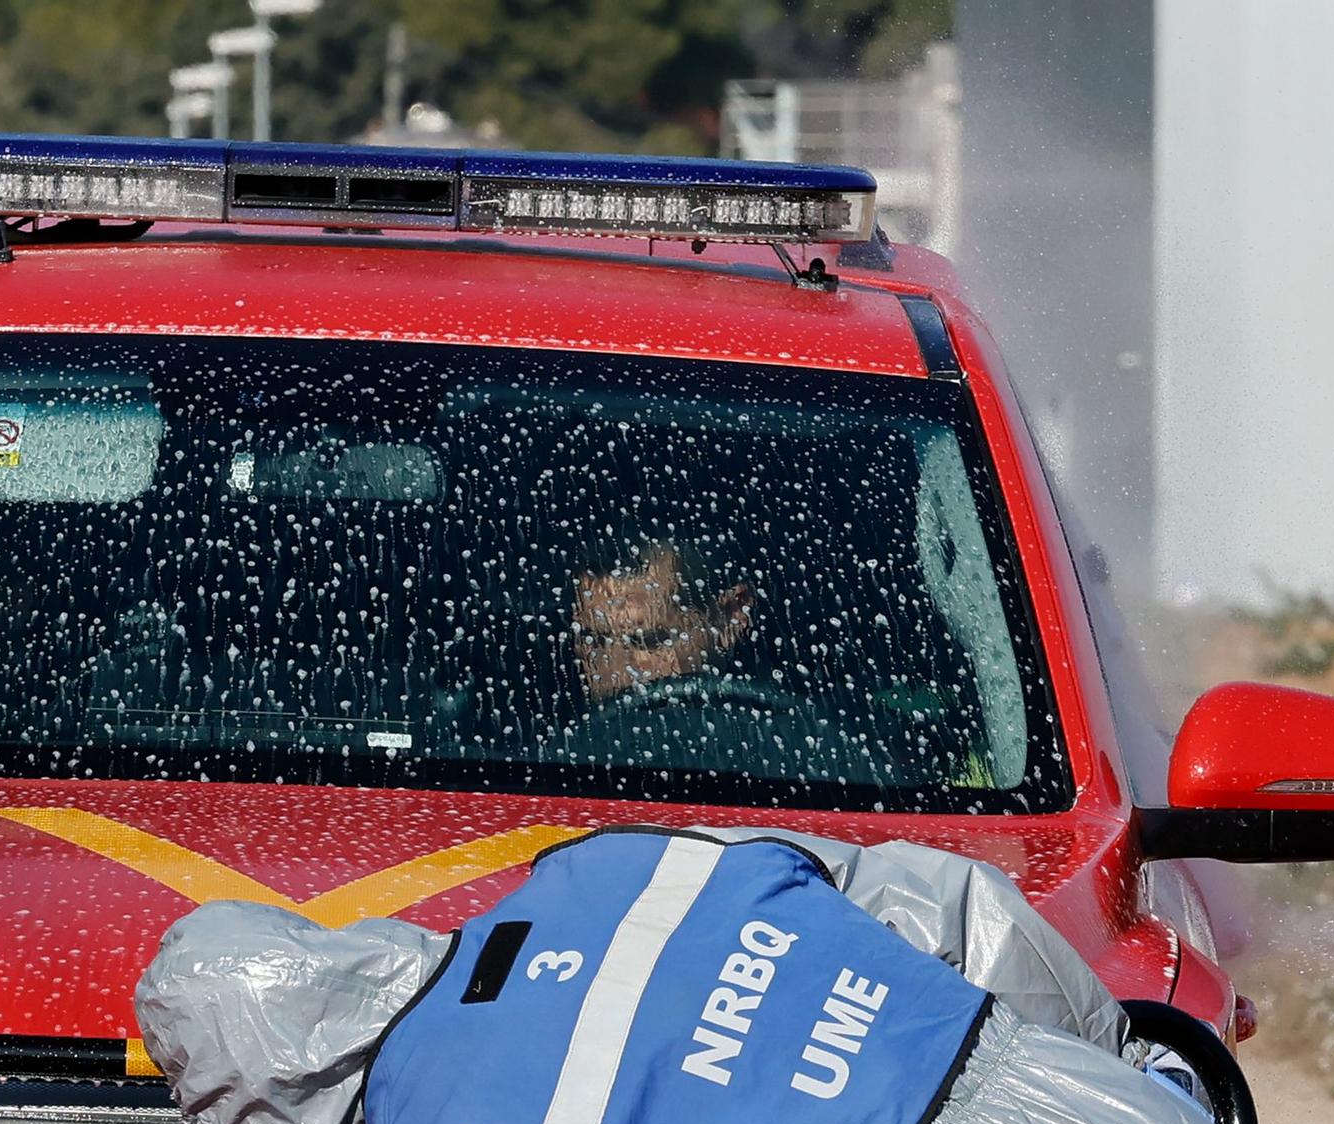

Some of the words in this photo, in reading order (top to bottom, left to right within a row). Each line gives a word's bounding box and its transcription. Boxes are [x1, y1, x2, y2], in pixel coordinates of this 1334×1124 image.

[526, 950, 584, 983] 3
[681, 920, 799, 1087] NRBQ
[790, 967, 890, 1100] UME
